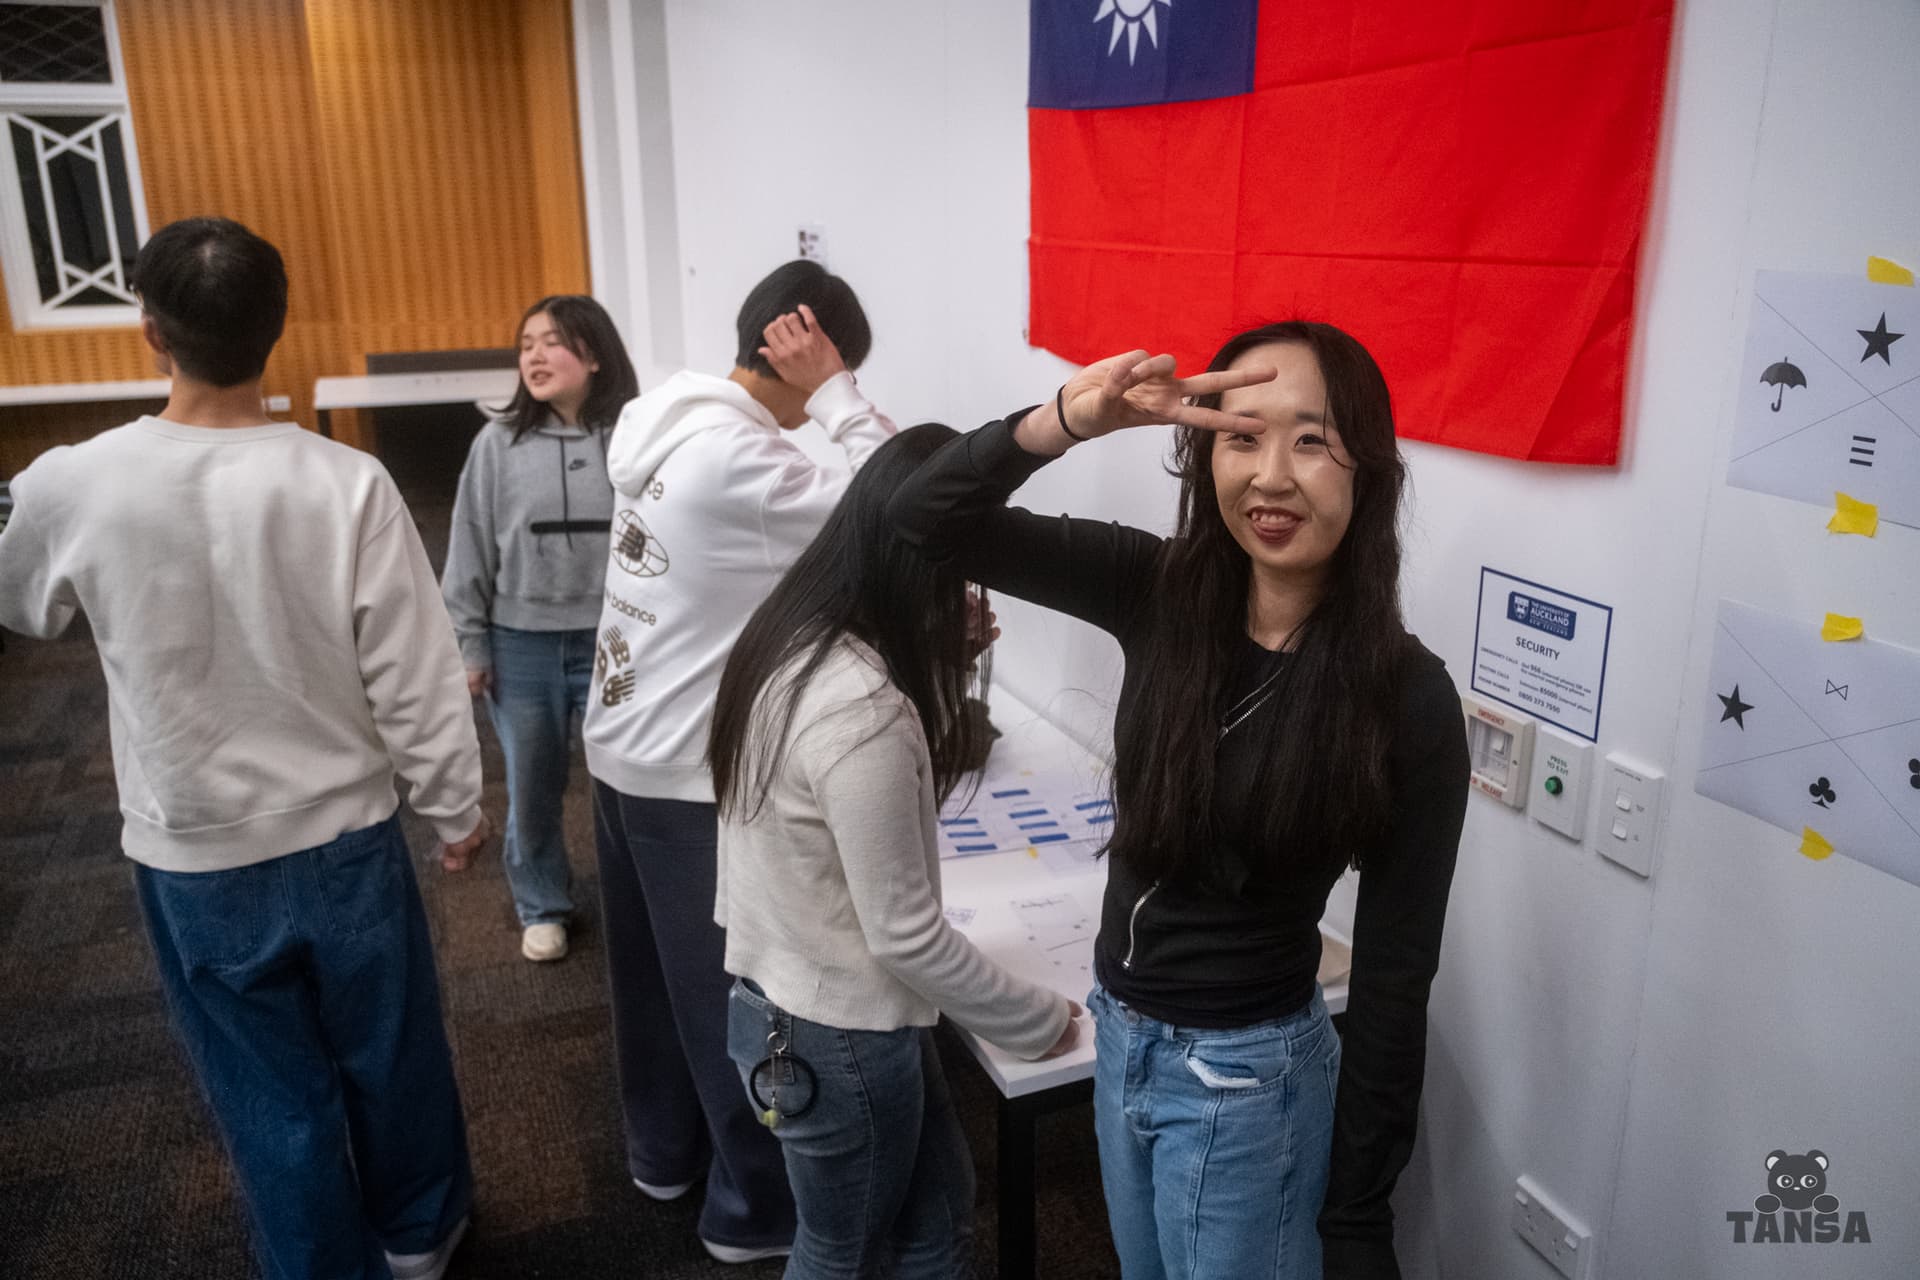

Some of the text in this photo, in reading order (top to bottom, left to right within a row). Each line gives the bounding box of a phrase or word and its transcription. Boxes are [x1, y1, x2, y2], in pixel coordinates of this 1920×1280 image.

[610, 592, 657, 626] balance
[1530, 607, 1569, 626] AUCKLAND
[1515, 635, 1560, 660] SECURITY
[1518, 691, 1533, 703] 0800
[1478, 708, 1504, 725] EMERGENCY
[1550, 755, 1568, 769] PRESS
[1481, 782, 1503, 801] RELEASE
